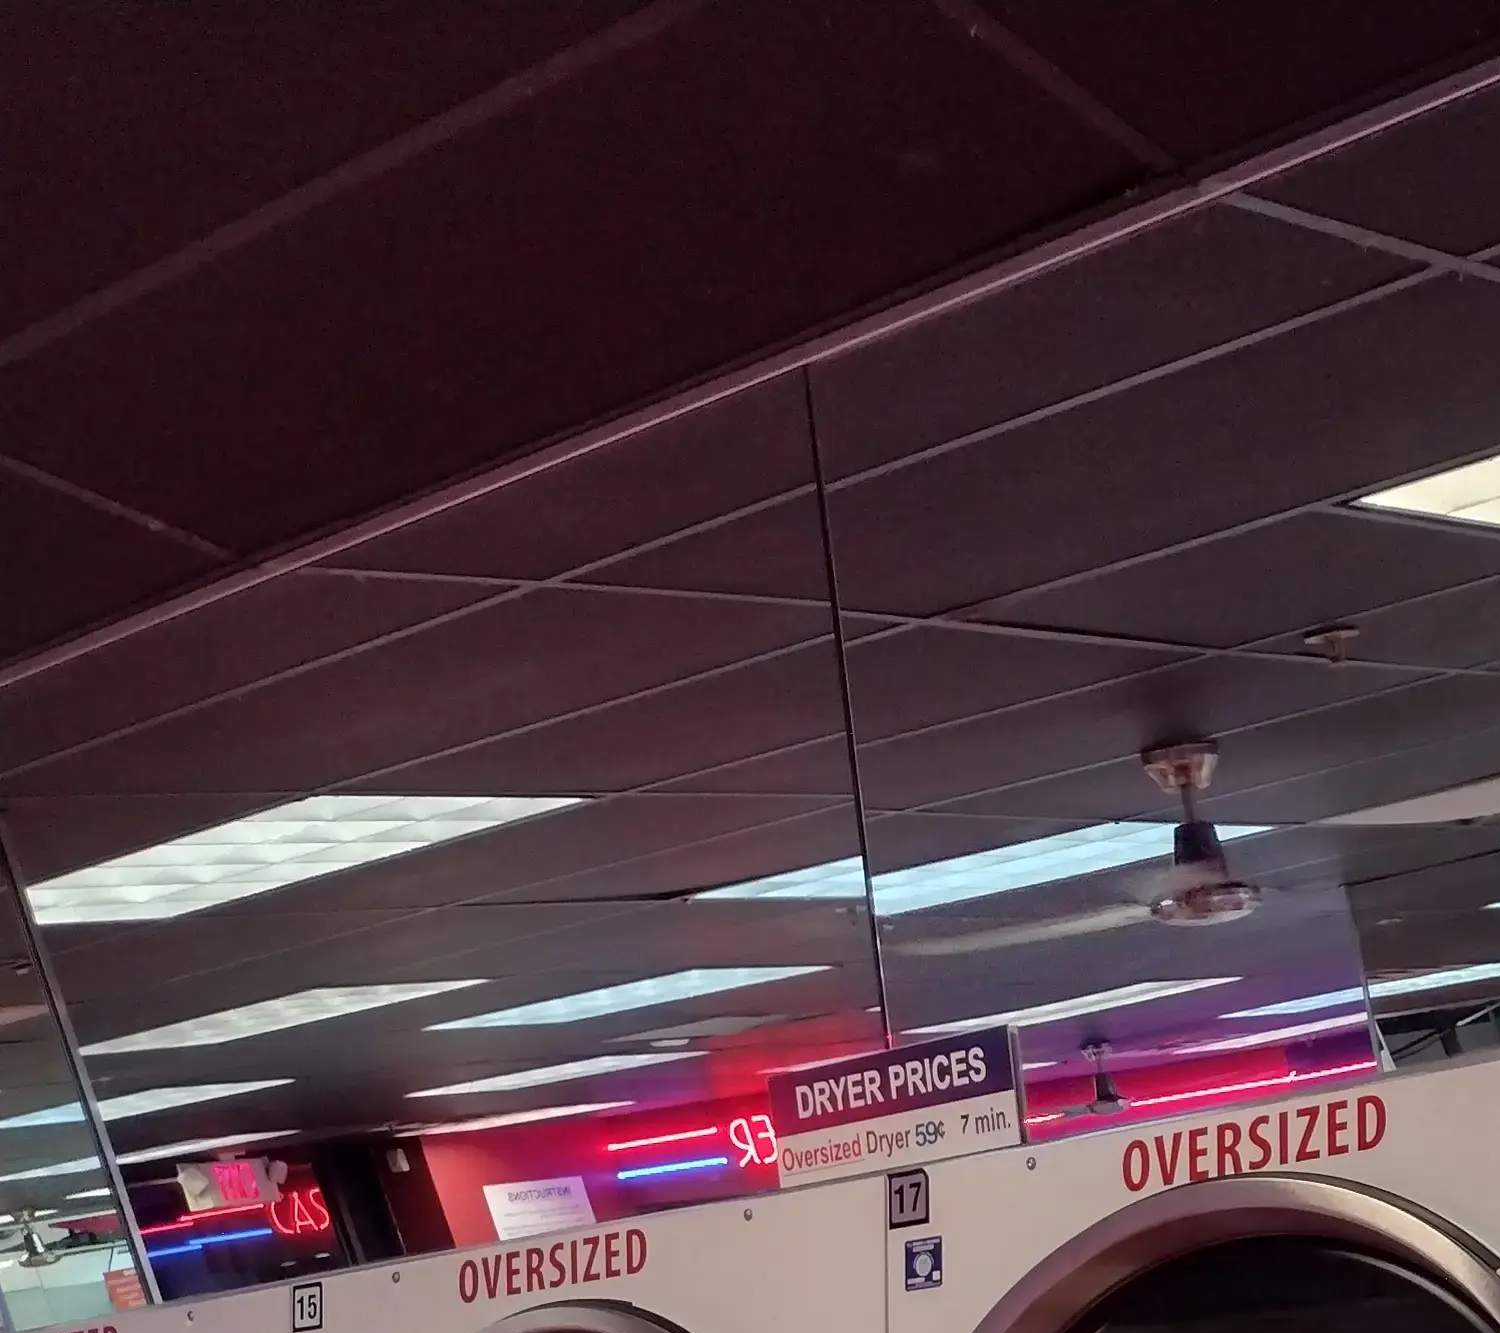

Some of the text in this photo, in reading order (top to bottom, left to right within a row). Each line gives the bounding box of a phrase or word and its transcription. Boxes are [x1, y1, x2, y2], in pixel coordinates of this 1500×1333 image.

[795, 1046, 987, 1119] DRYER PRICES
[782, 1107, 1011, 1171] Oversized Dryer 59¢ 7 min.
[1122, 1095, 1387, 1192] OVERSIZED
[894, 1182, 922, 1215] 17
[459, 1229, 648, 1303] OVERSIZED
[297, 1294, 317, 1320] 15
